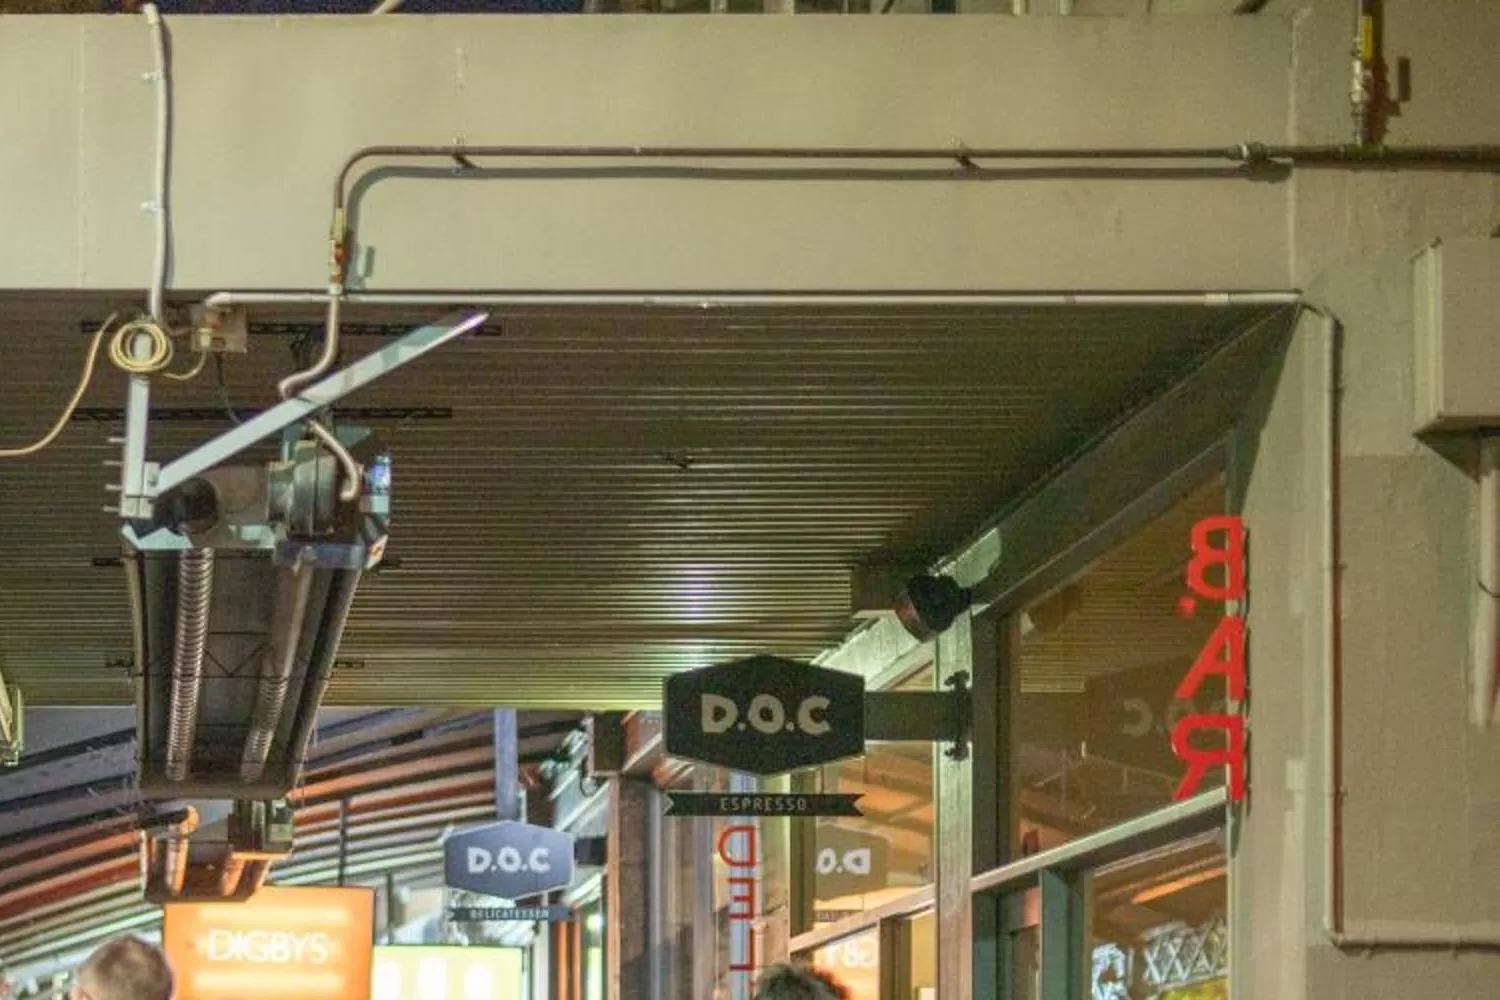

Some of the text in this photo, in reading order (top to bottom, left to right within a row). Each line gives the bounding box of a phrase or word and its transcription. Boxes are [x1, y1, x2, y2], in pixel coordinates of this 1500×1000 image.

[701, 693, 831, 736] D.O.C
[719, 796, 807, 812] ESPRESSO
[467, 846, 550, 874] D.O.C
